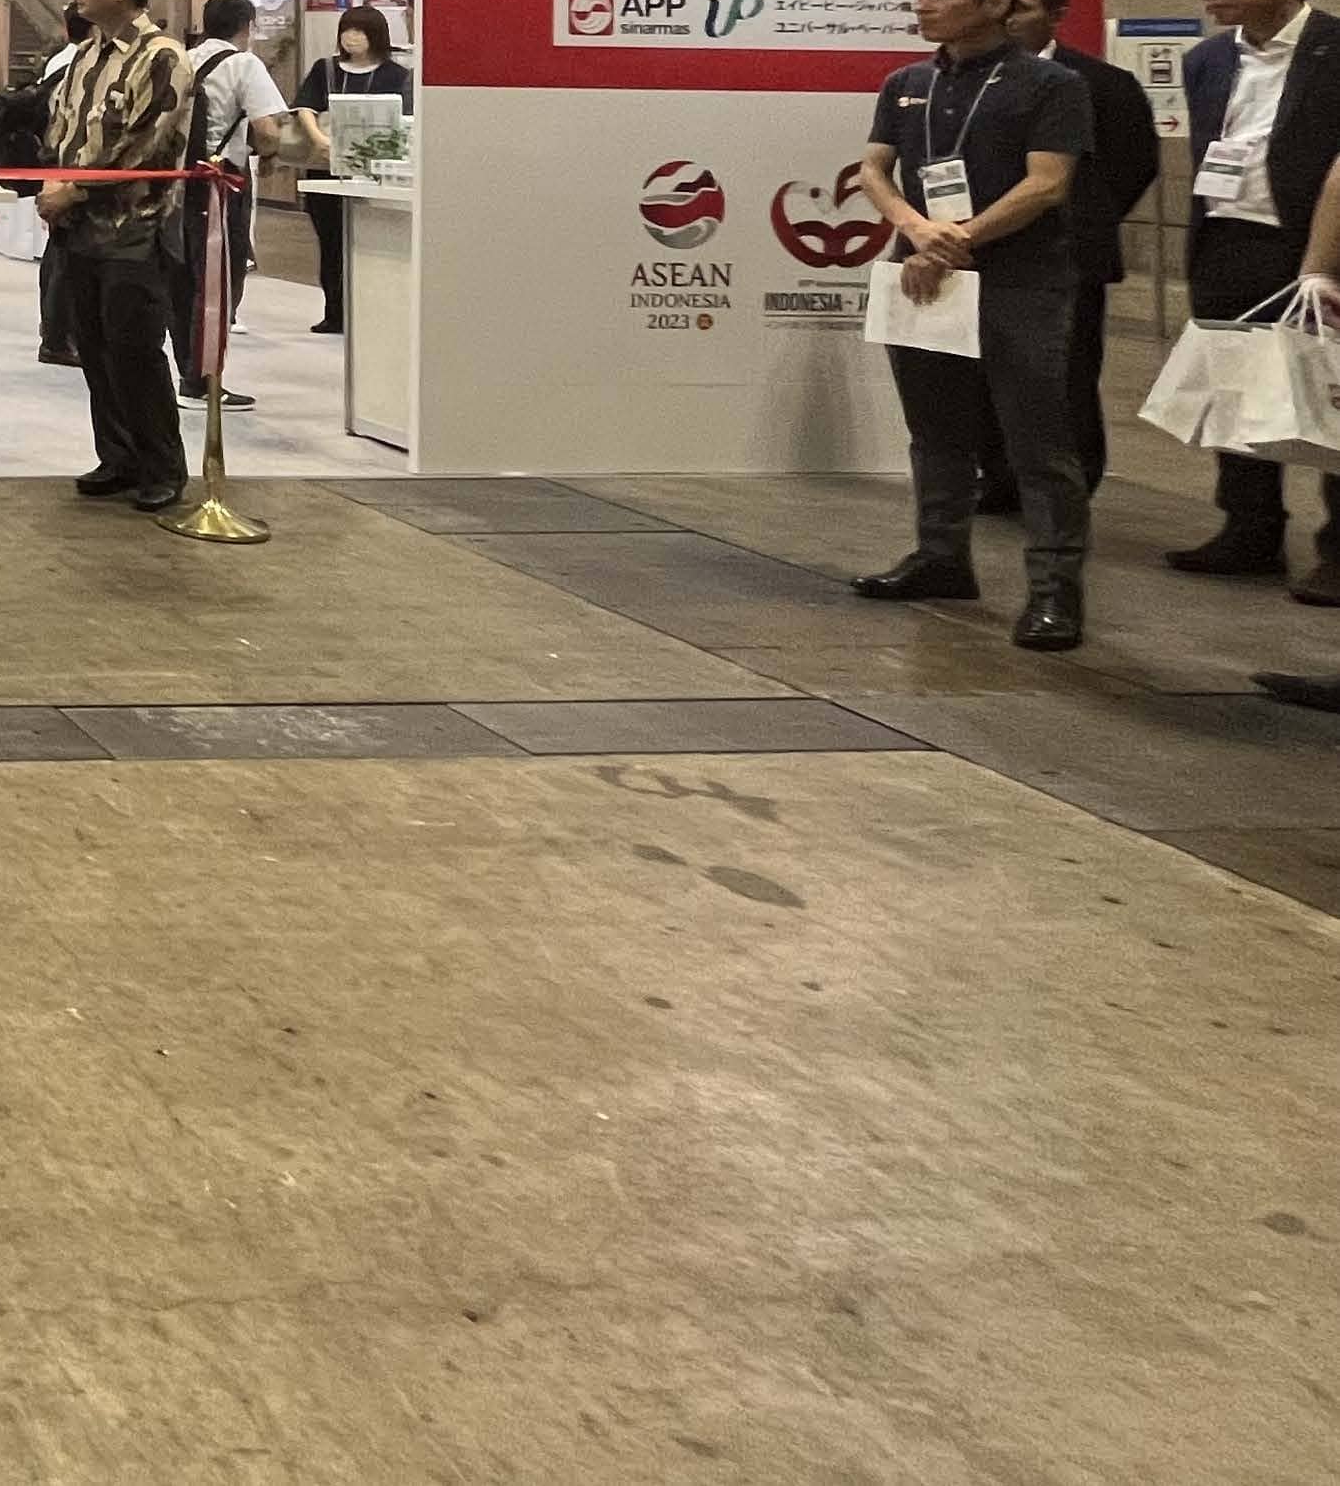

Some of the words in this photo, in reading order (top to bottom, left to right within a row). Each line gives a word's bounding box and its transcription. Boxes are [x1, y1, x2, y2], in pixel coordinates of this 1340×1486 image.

[620, 23, 690, 35] sinarmas
[631, 262, 733, 287] ASEAN
[630, 293, 731, 309] INDONESIA
[764, 292, 842, 311] INDONESIA
[647, 314, 690, 330] 2023
